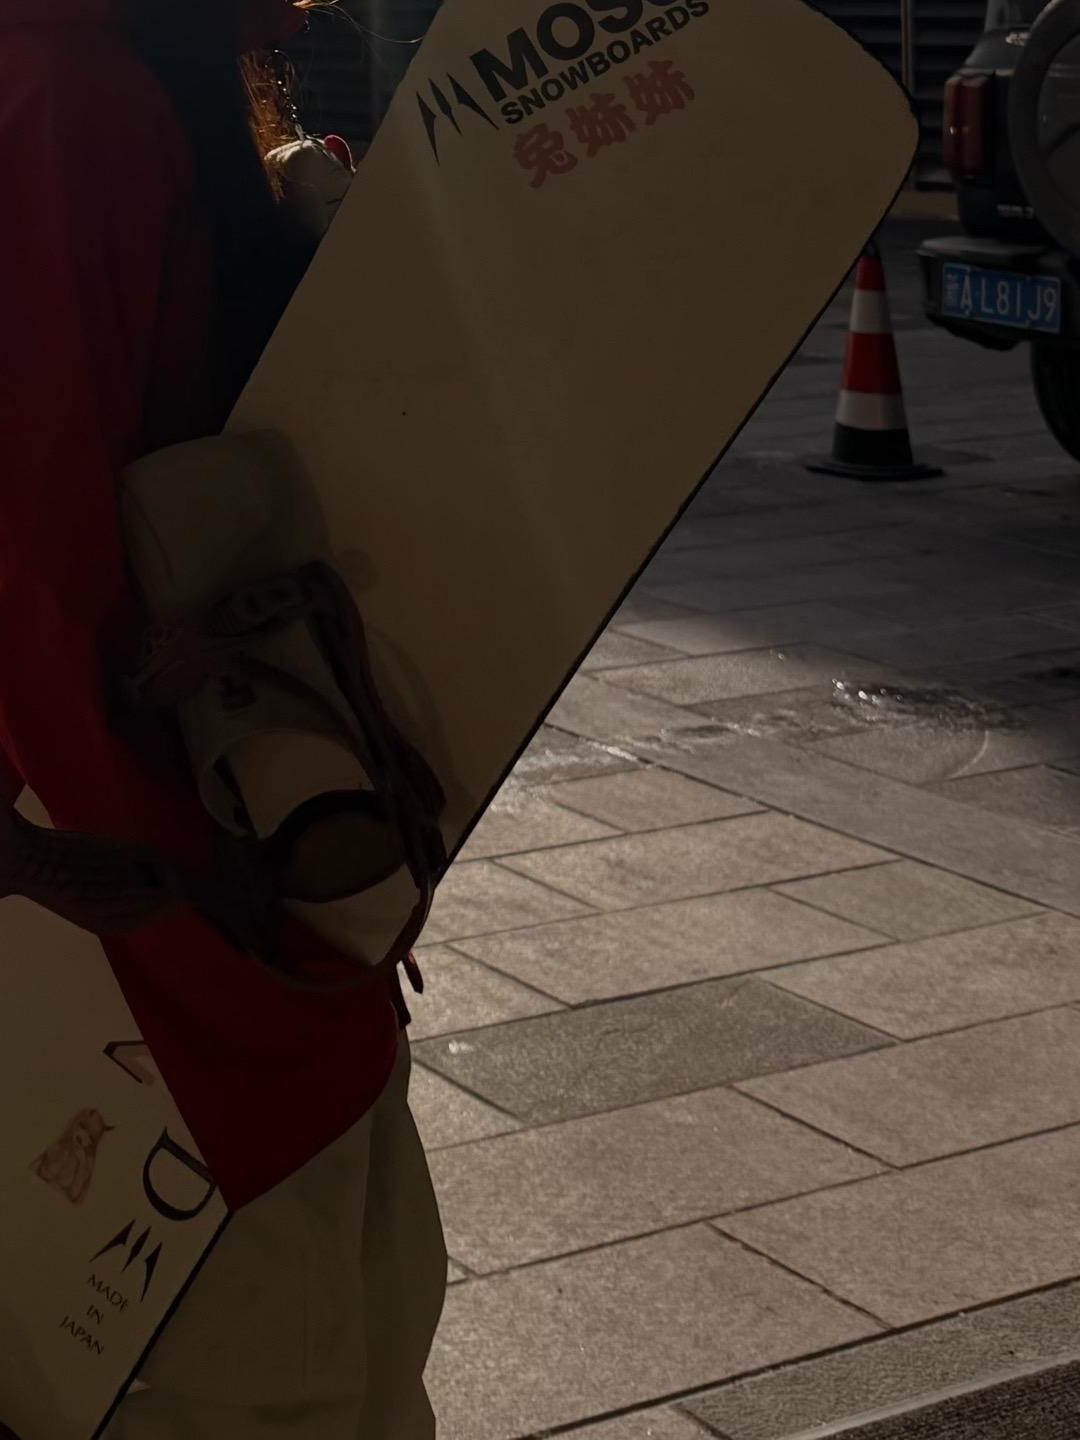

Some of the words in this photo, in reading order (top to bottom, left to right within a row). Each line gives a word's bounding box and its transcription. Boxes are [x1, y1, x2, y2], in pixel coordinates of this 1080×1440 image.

[87, 1273, 129, 1311] MADE
[86, 1305, 104, 1325] IN
[60, 1315, 104, 1355] JAPAN
